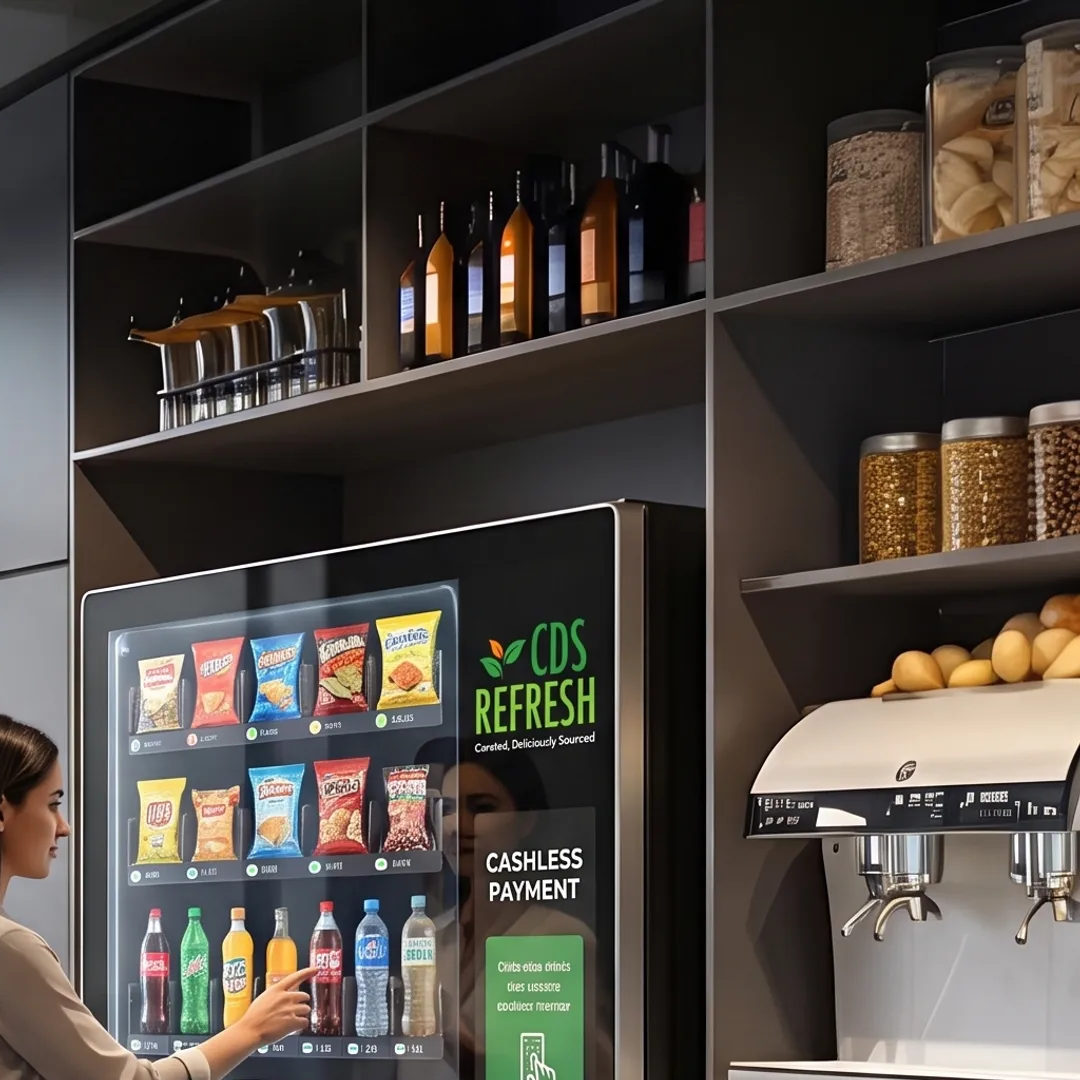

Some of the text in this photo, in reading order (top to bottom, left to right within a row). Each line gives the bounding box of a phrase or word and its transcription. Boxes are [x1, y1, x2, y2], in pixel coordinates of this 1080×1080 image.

[531, 618, 586, 675] CDS
[475, 677, 595, 735] REFRESH
[511, 737, 556, 749] Deliciously
[558, 731, 595, 744] Sourced
[486, 848, 583, 874] CASHLESS
[489, 878, 580, 902] PAYMENT
